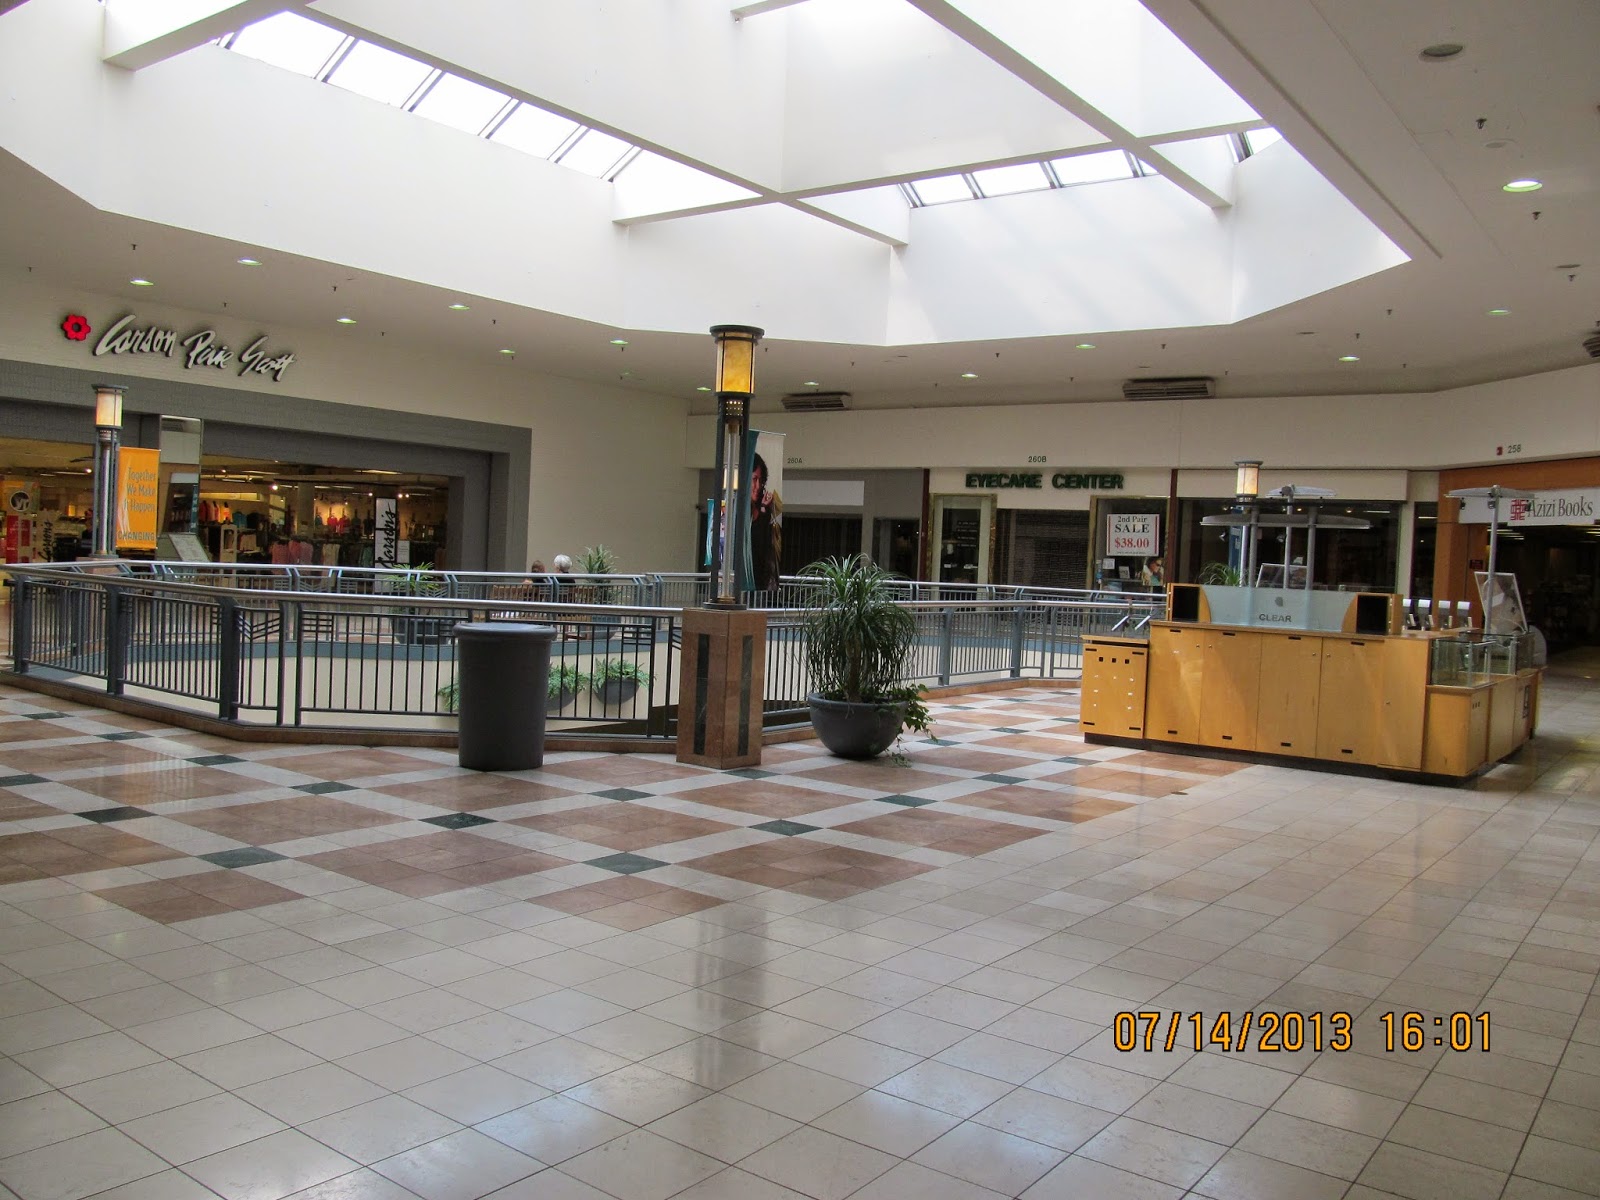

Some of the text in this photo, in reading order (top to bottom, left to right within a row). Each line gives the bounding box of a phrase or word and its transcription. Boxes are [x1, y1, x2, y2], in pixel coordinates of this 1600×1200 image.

[93, 314, 296, 382] Carson Pirie Scott
[1507, 444, 1521, 454] 258
[128, 467, 156, 482] Together
[965, 473, 1124, 489] EYECARE CENTER
[127, 484, 155, 497] We Make
[131, 499, 155, 513] Happen
[1527, 496, 1594, 518] Azizi Books
[1117, 515, 1147, 523] 2nd Pair
[1115, 524, 1150, 533] SALE
[118, 531, 155, 541] CHANGING
[1115, 537, 1150, 548] $38.00
[1259, 613, 1292, 622] CLEAR
